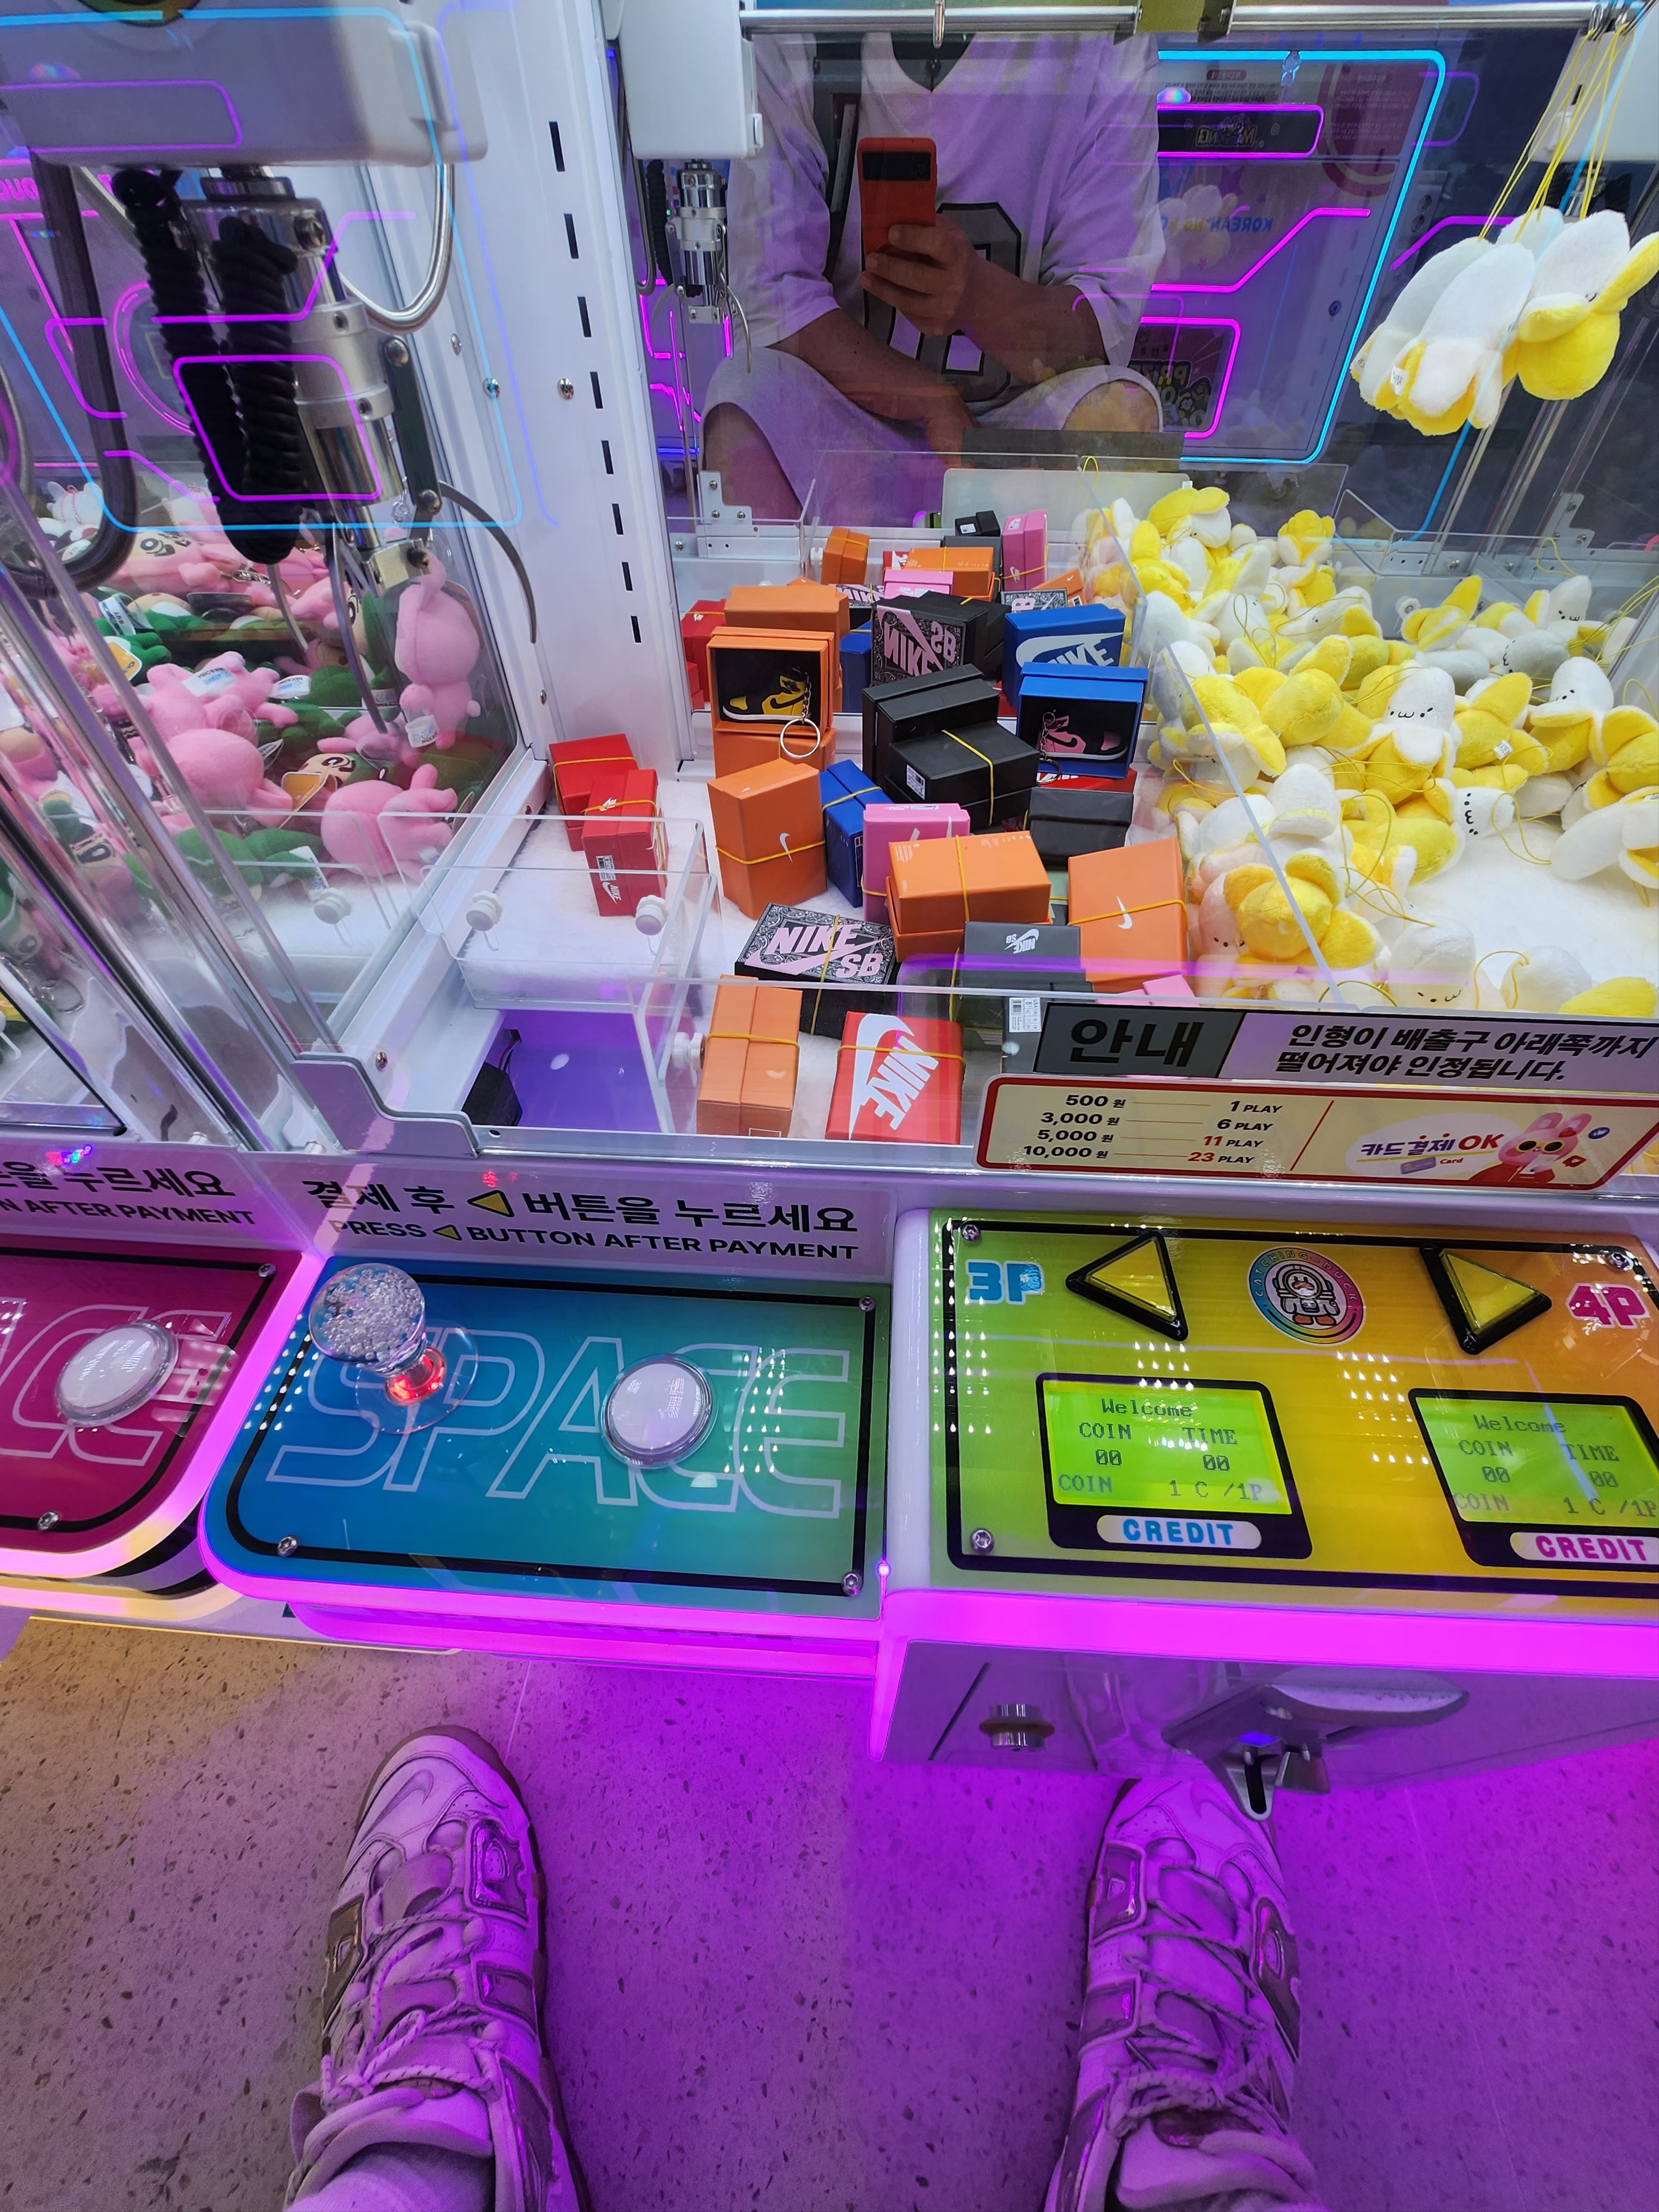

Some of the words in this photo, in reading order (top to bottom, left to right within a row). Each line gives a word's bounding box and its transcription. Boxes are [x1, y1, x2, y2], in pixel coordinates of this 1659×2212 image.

[610, 885, 622, 901] NIKE
[765, 924, 862, 956] NIKE
[1006, 933, 1018, 944] SB
[1013, 938, 1036, 954] NIKE
[835, 953, 884, 978] SB
[1070, 1019, 1205, 1068] 안내
[1288, 1024, 1390, 1050] 인형이
[1389, 1027, 1489, 1053] 배출구
[1494, 1030, 1658, 1059] 아래쪽까지
[1275, 1051, 1404, 1076] 떨어져야
[1404, 1055, 1566, 1082] 인정됩니다.
[863, 1035, 940, 1130] NIKE
[1065, 1094, 1109, 1107] 500
[1112, 1098, 1126, 1108] 원
[1229, 1100, 1240, 1113] 1
[1242, 1104, 1283, 1114] PLAY
[1040, 1112, 1103, 1126] 3,000
[1107, 1116, 1120, 1126] 원
[1217, 1119, 1232, 1130] 6
[1234, 1122, 1274, 1131] PLAY
[1037, 1129, 1097, 1143] 5,000
[1101, 1133, 1114, 1143] 원
[1203, 1135, 1223, 1147] 11
[1225, 1139, 1264, 1148] PLAY
[1360, 1138, 1456, 1156] 카드결제
[1457, 1133, 1505, 1152] OK
[1023, 1145, 1092, 1159] 10,000
[1095, 1149, 1109, 1159] 원
[1187, 1152, 1215, 1162] 23
[1217, 1155, 1255, 1164] PLAY
[1439, 1156, 1464, 1165] Card
[24, 1198, 120, 1218] AFTER
[114, 1203, 255, 1225] PAYMENT
[301, 1180, 401, 1212] 결제
[403, 1186, 455, 1215] 후
[521, 1192, 661, 1225] 버튼을
[674, 1199, 858, 1233] 누르세요
[328, 1219, 427, 1238] PRESS
[466, 1226, 596, 1247] BUTTON
[604, 1233, 703, 1252] AFTER
[709, 1238, 859, 1260] PAYMENT
[967, 1261, 1044, 1304] 3P
[1567, 1284, 1648, 1327] 4P
[1102, 1397, 1193, 1417] Welcome
[1079, 1422, 1132, 1441] COIN
[1182, 1426, 1238, 1446] TIME
[1473, 1414, 1567, 1434] Welcome
[1095, 1449, 1123, 1467] 00
[1203, 1455, 1230, 1472] 00
[1459, 1439, 1514, 1458] COIN
[1562, 1443, 1620, 1463] TIME
[1058, 1474, 1113, 1494] COIN
[1168, 1479, 1182, 1497] 1
[1194, 1480, 1209, 1498] C
[1481, 1466, 1511, 1484] 00
[1588, 1470, 1619, 1488] 00
[1453, 1492, 1511, 1512] COIN
[1563, 1497, 1579, 1515] 1
[1589, 1498, 1606, 1516] C
[1122, 1519, 1234, 1546] CREDIT
[1535, 1535, 1648, 1562] CREDIT
